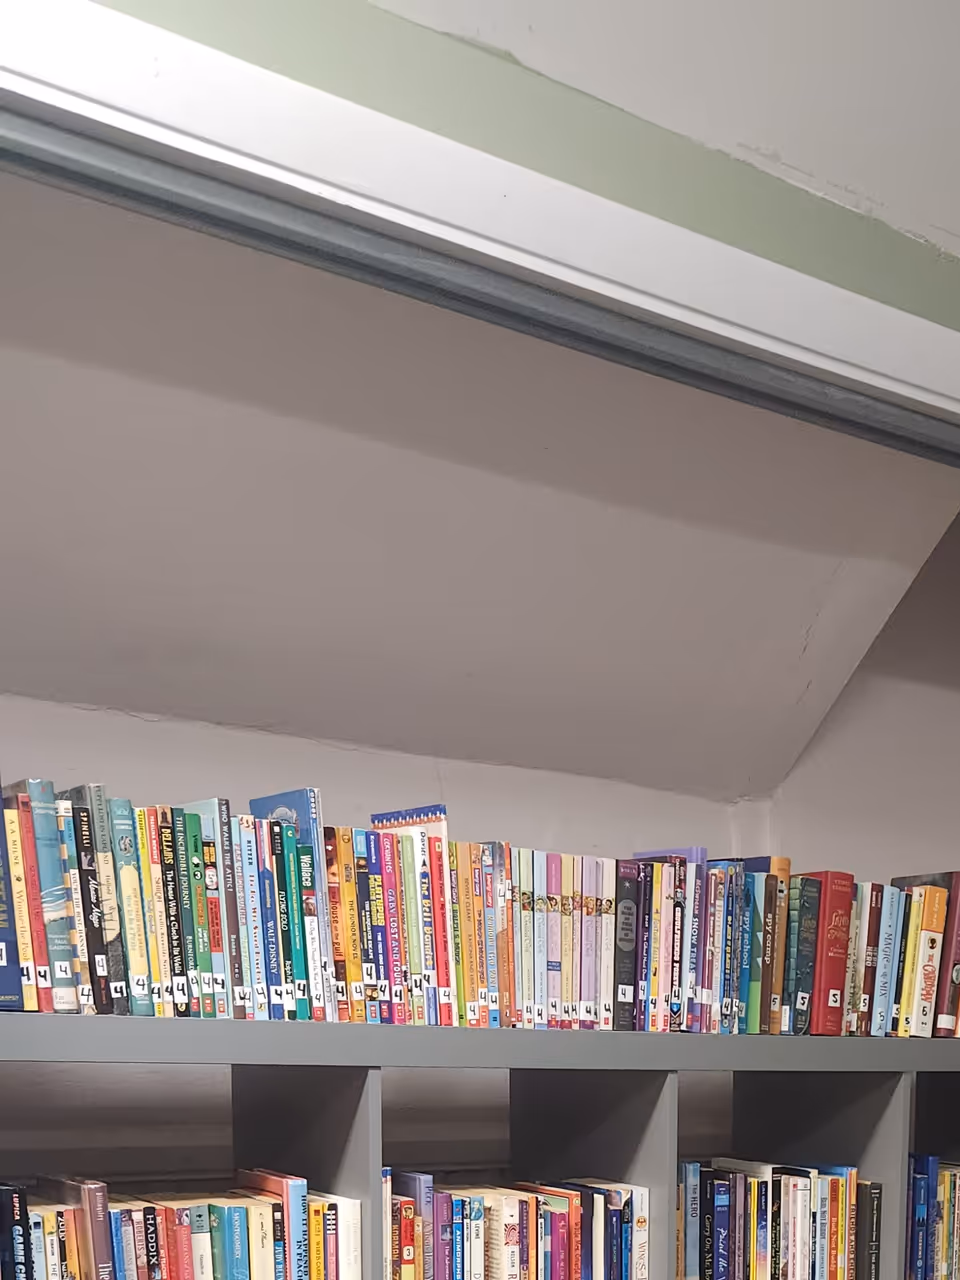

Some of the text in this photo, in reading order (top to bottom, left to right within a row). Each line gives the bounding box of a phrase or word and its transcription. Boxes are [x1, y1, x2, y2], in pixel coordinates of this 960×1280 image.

[80, 812, 90, 847] SPINELLI
[162, 828, 174, 864] BELLAIRS
[176, 817, 190, 909] THE INCREDIBLE JOURNEY
[300, 855, 314, 886] Wallace
[280, 914, 288, 930] SOLO
[766, 913, 774, 931] spy
[387, 889, 402, 985] GABY LOST AND FOUN
[12, 1194, 21, 1221] LUPICA
[690, 1197, 699, 1218] HERO
[703, 1215, 712, 1236] Carry
[12, 1225, 27, 1263] GAME
[146, 1214, 158, 1265] HADDIX
[704, 1238, 712, 1250] On,
[714, 1228, 727, 1253] Paint
[275, 1246, 284, 1262] JUDY
[718, 1257, 727, 1273] the
[98, 1262, 113, 1280] The
